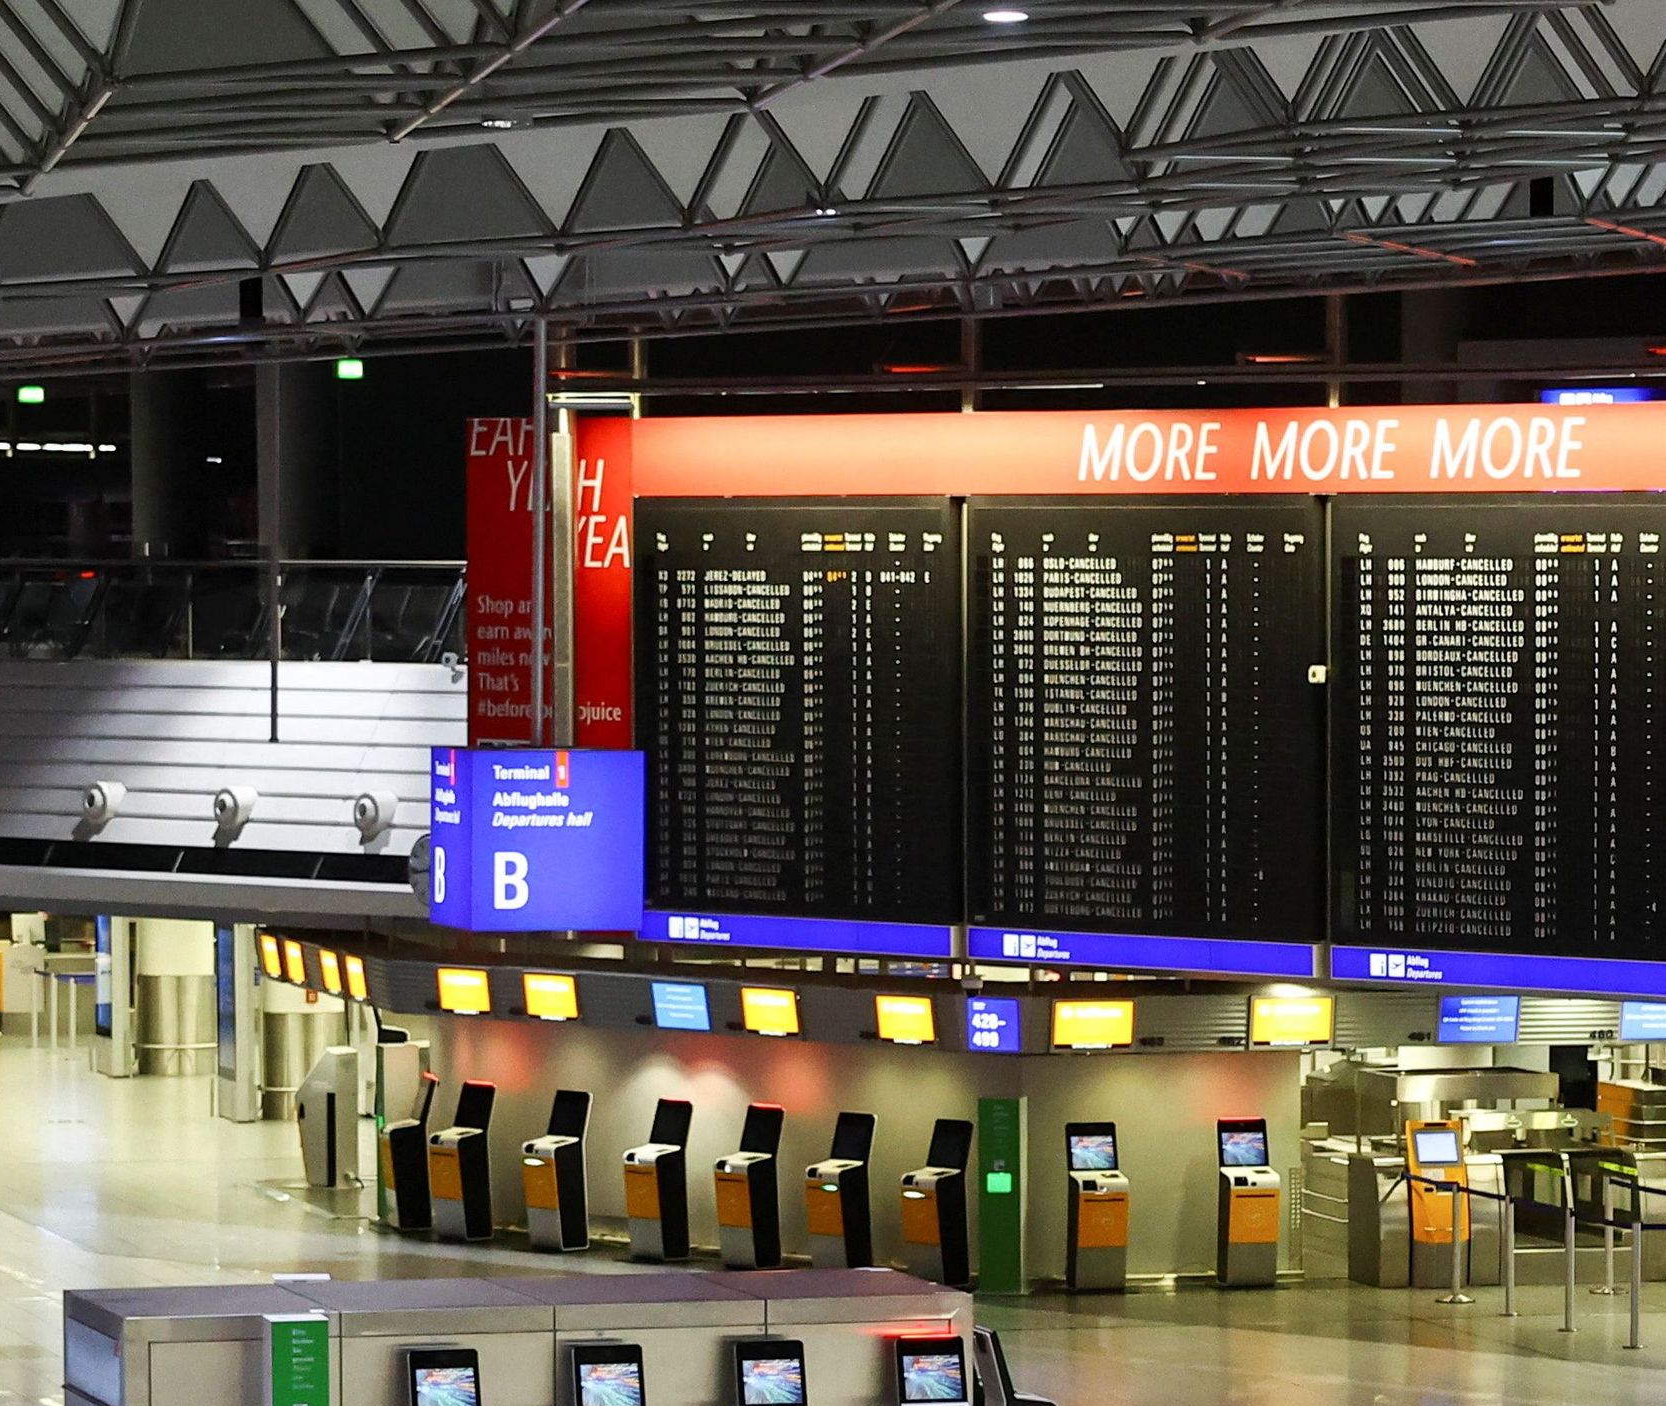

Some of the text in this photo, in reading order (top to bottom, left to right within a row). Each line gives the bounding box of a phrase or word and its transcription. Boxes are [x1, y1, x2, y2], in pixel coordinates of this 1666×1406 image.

[1078, 417, 1586, 481] MORE MORE MORE
[478, 596, 514, 620] Shop
[477, 626, 509, 639] earn
[478, 649, 514, 666] miles
[478, 672, 519, 691] That's
[493, 765, 566, 780] Terminal 1
[492, 792, 569, 809] Abflughalle
[492, 812, 593, 829] Departures hall
[434, 846, 446, 904] B
[494, 852, 529, 910] B
